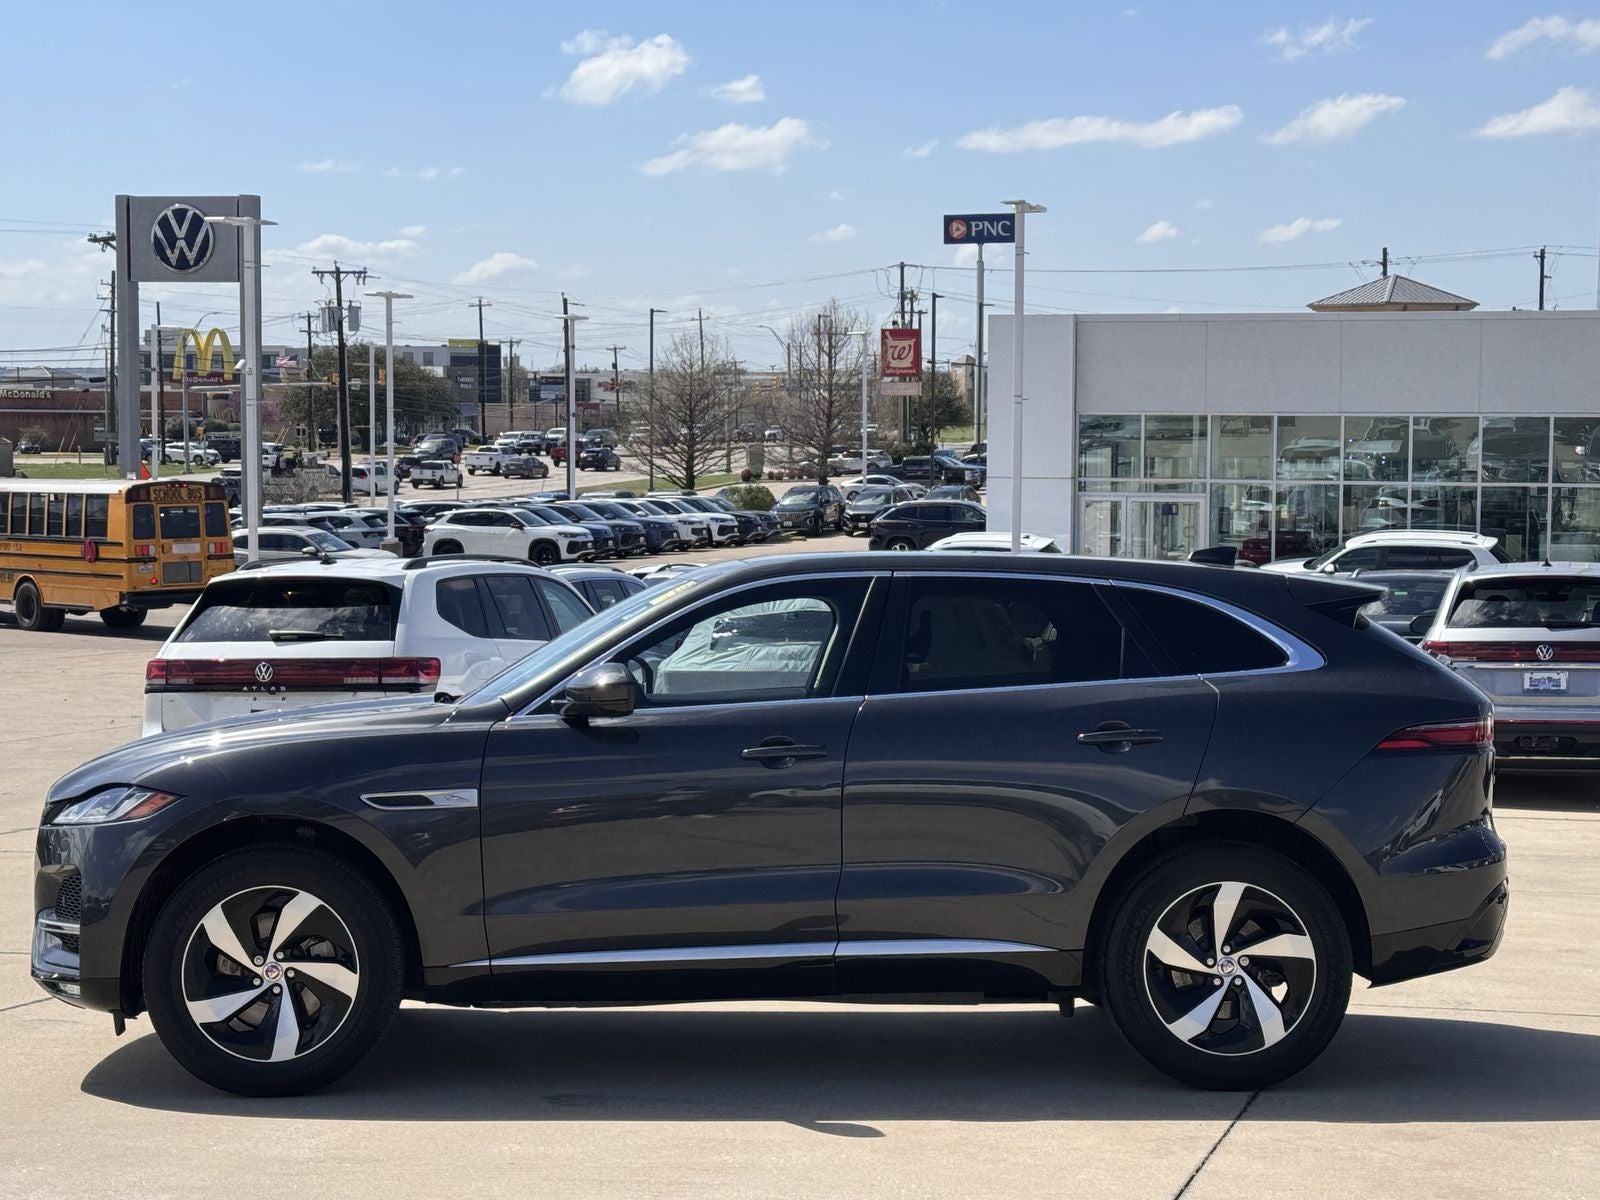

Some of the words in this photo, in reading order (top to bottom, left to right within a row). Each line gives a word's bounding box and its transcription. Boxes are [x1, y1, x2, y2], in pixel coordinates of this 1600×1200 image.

[970, 220, 1011, 237] PNC
[0, 389, 52, 399] McDonald's
[153, 487, 184, 500] SCHOOL
[187, 486, 202, 499] BUS
